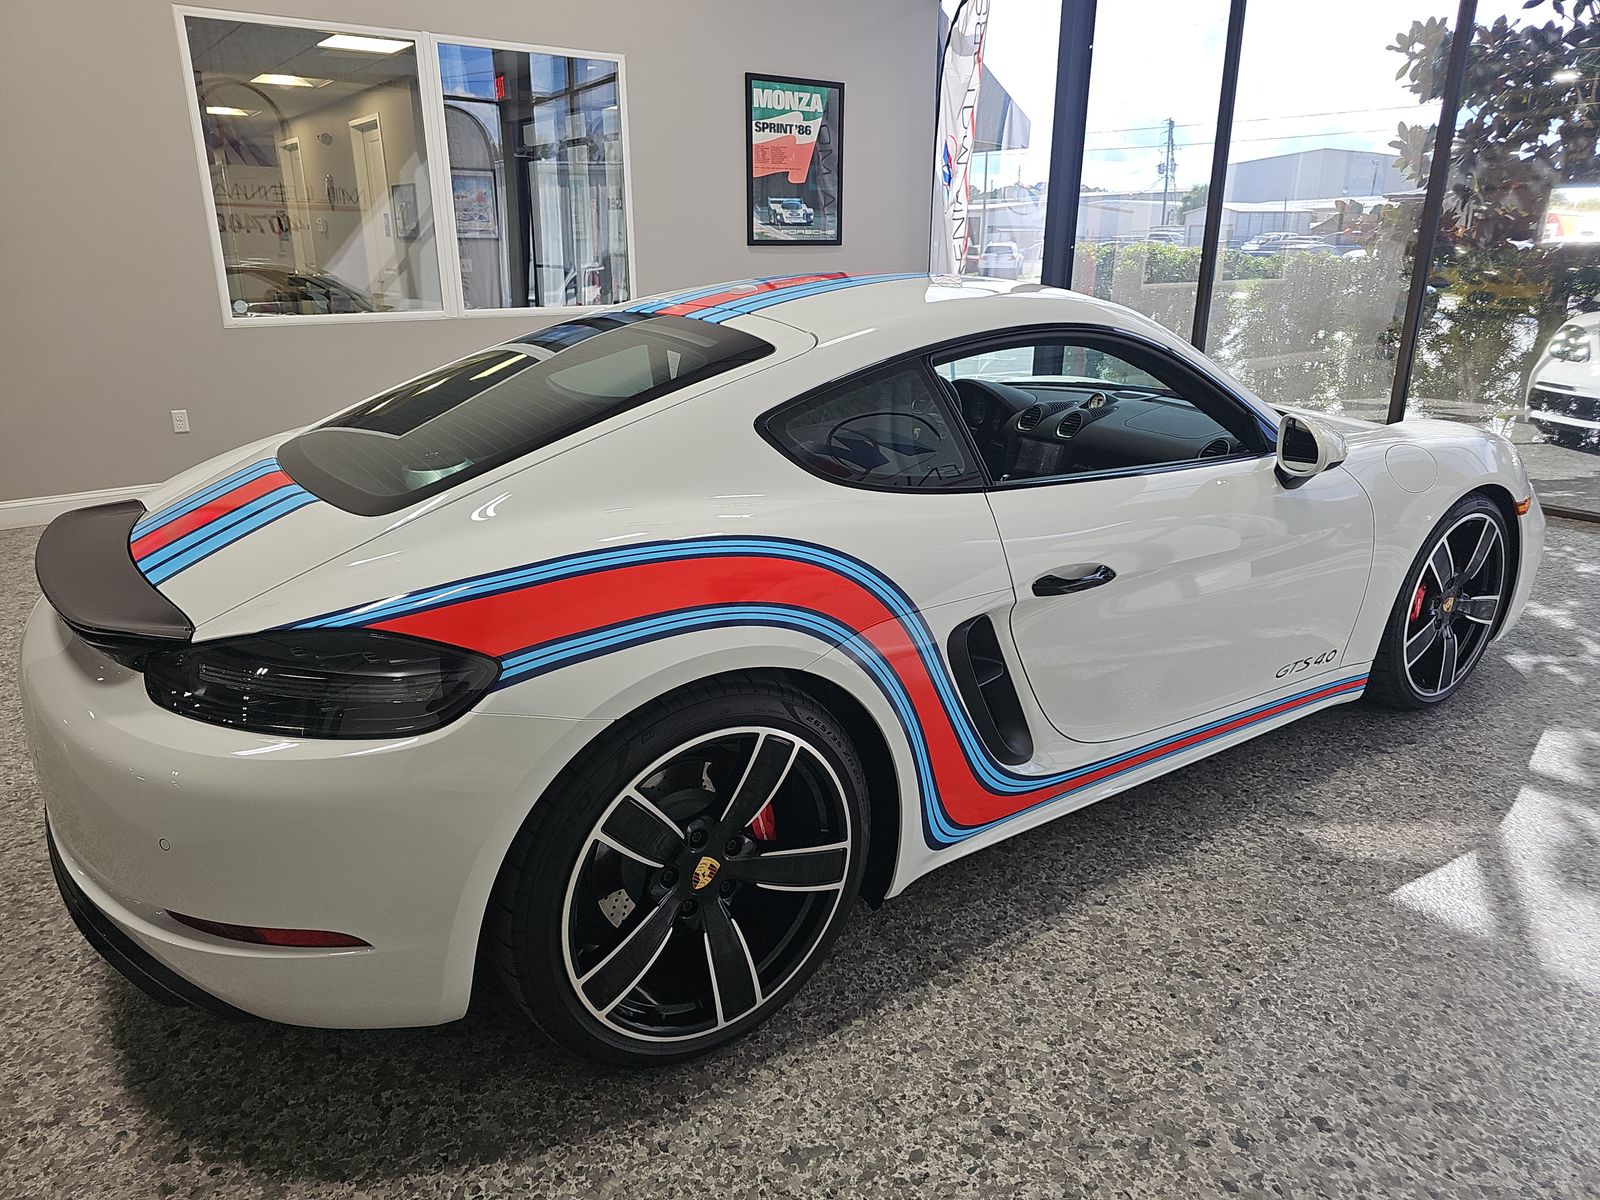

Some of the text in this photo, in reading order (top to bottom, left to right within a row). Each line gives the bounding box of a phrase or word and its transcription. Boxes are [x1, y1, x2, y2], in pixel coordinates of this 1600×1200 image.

[753, 88, 823, 113] MONZA
[754, 121, 812, 136] SPRINT '86
[1275, 649, 1338, 679] GTS 4.0
